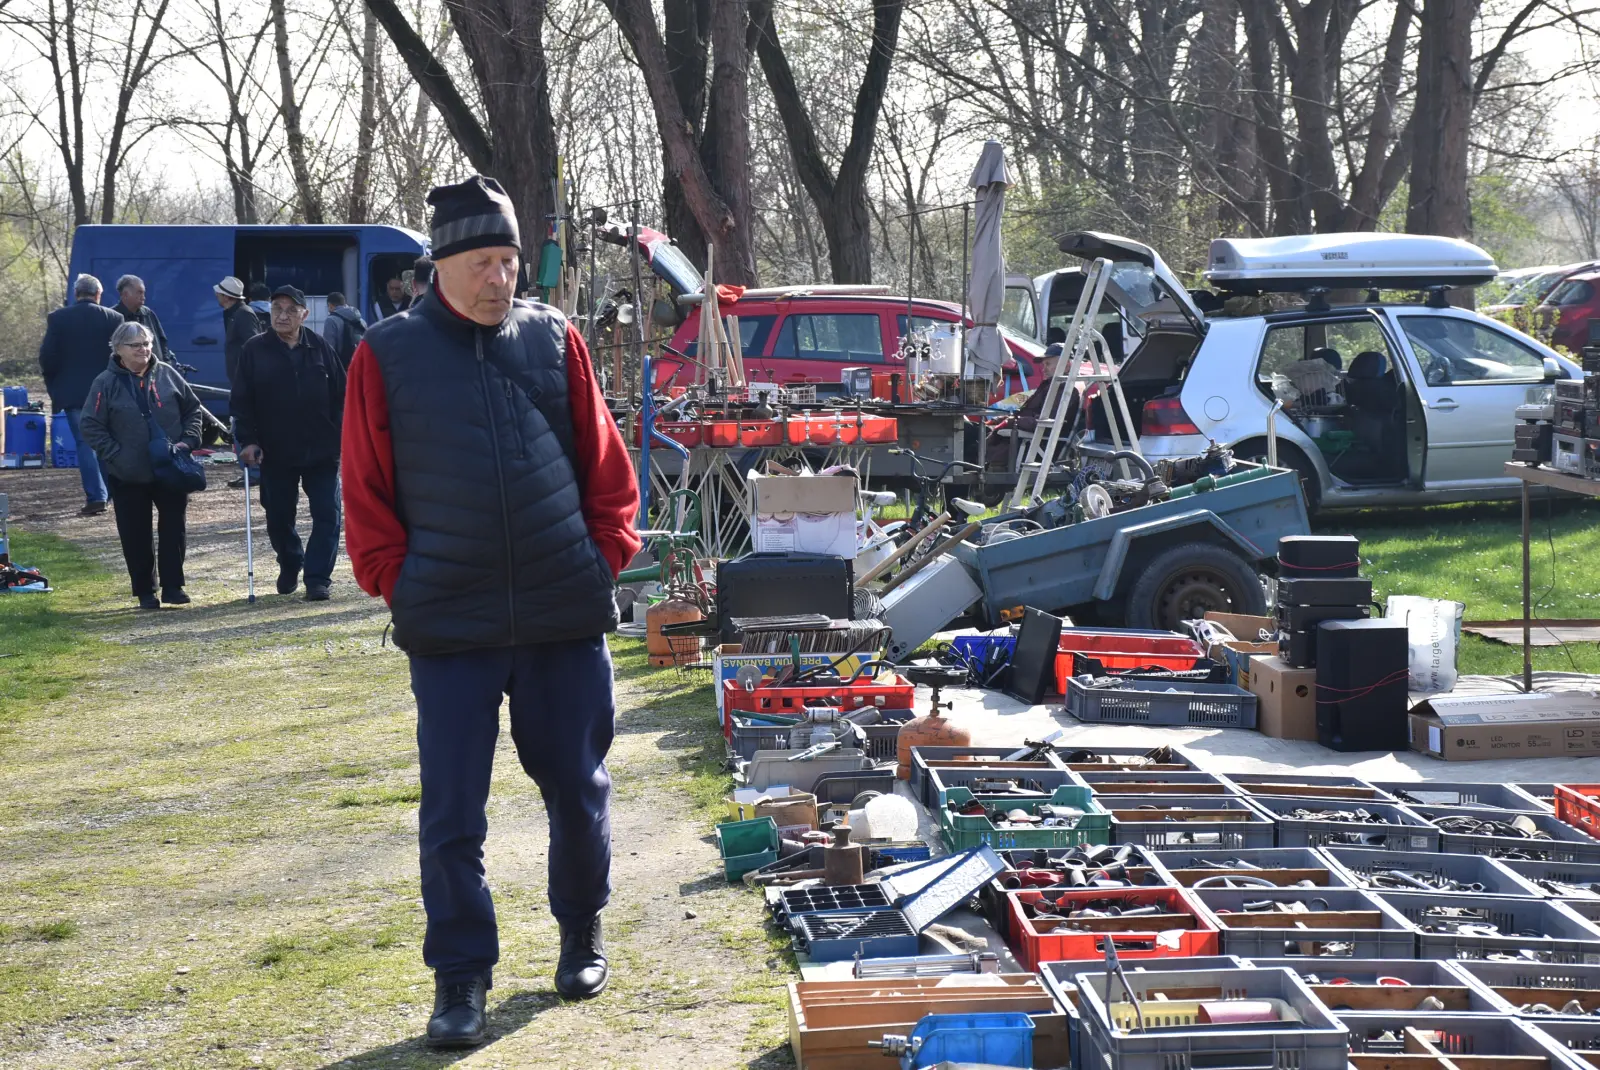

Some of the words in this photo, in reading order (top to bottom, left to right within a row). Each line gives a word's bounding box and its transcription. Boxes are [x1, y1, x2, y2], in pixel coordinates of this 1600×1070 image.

[722, 657, 772, 668] BANANAS
[774, 656, 822, 667] PREIUM
[1462, 699, 1516, 707] MONITOR
